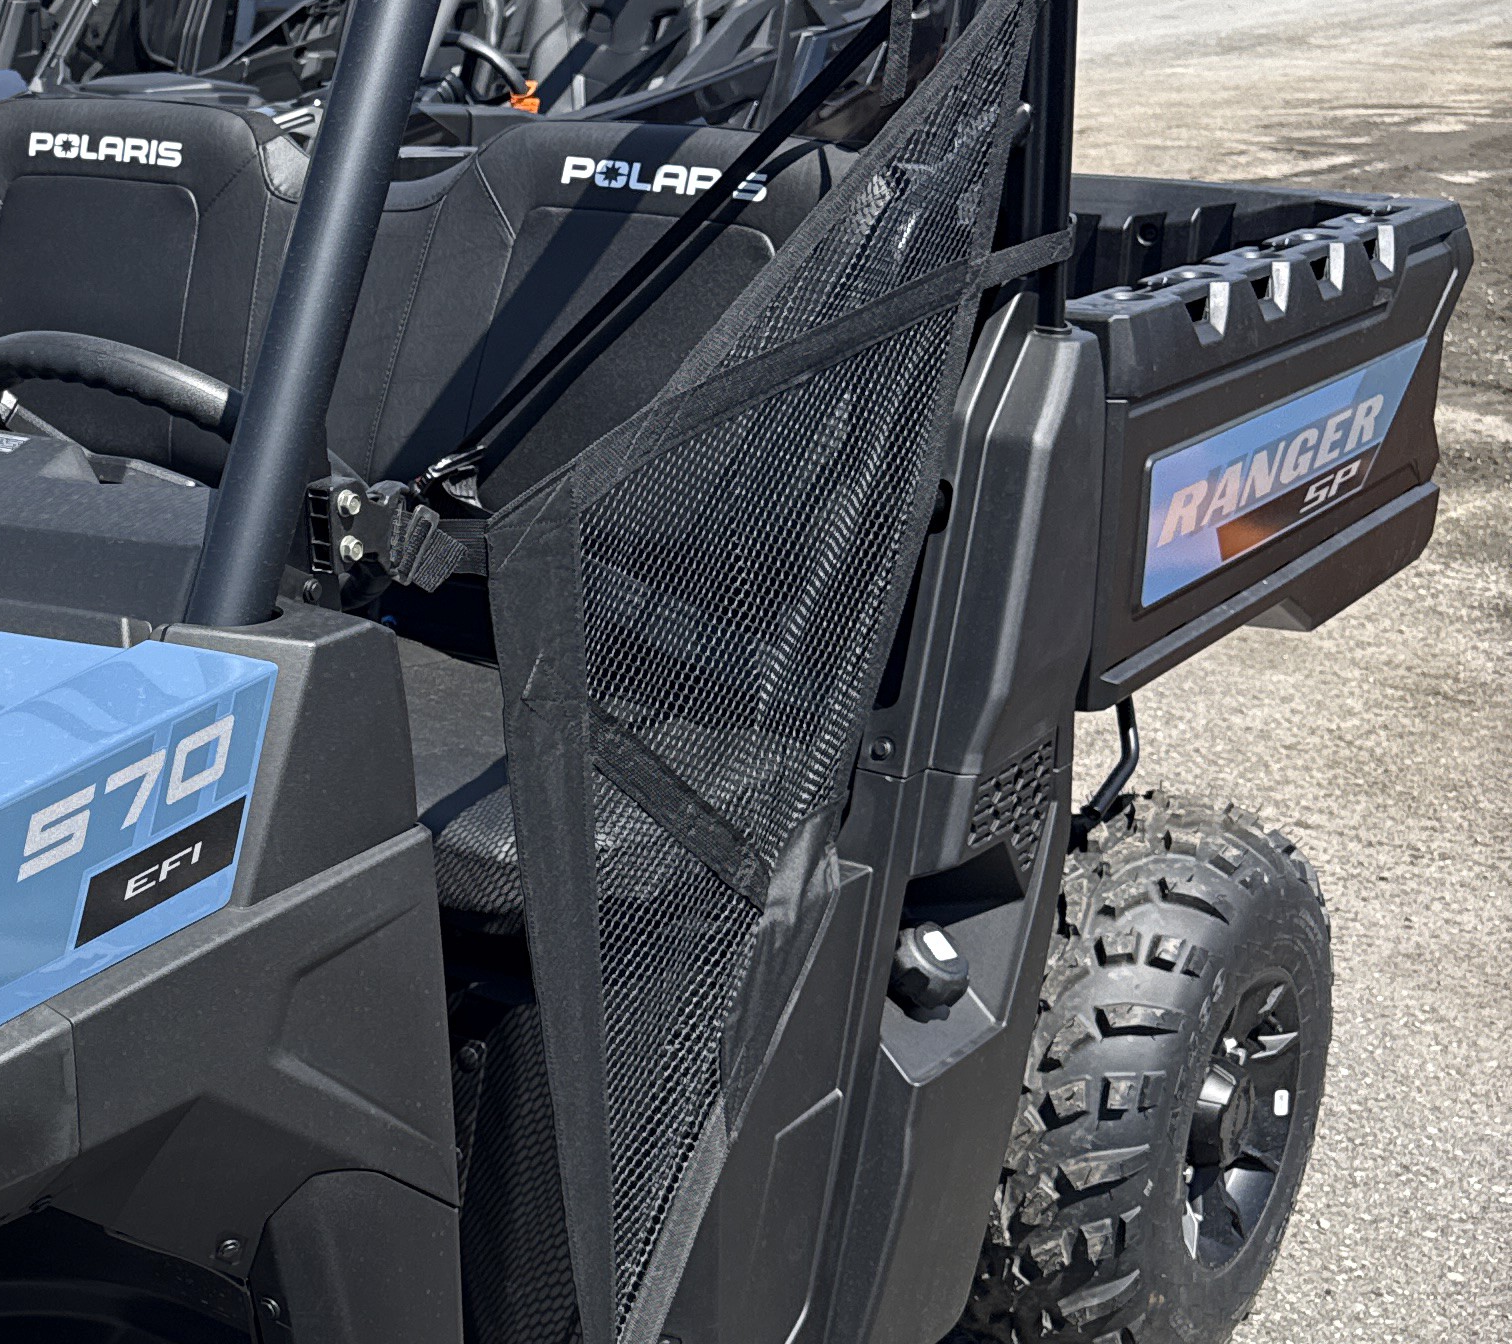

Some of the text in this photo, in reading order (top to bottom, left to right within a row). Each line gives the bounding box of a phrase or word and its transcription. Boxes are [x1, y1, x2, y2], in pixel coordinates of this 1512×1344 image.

[28, 131, 183, 168] POLARIS
[560, 155, 768, 202] POLARS
[1156, 394, 1385, 548] RANGER
[1299, 459, 1362, 514] SP
[124, 841, 203, 901] EFI
